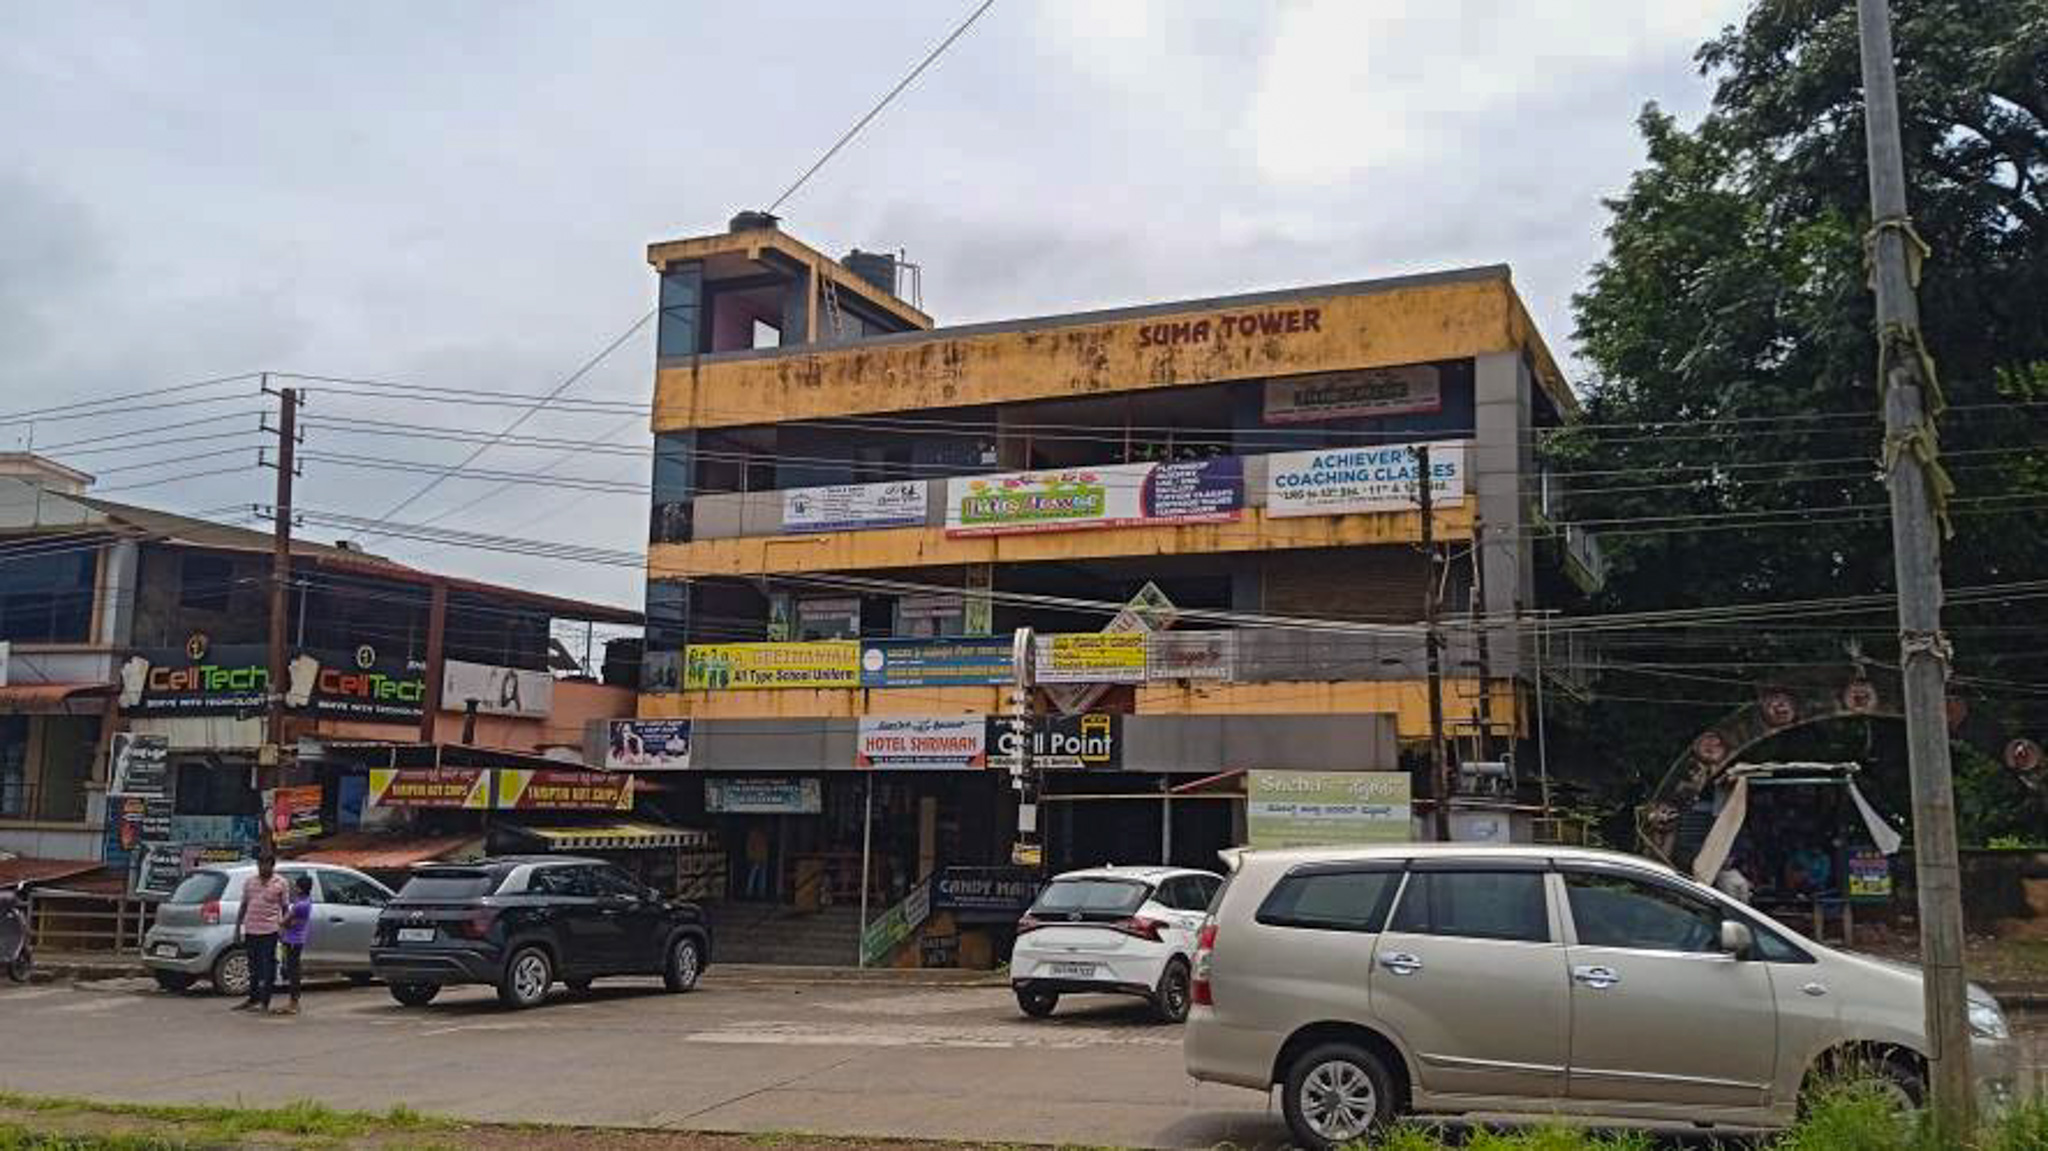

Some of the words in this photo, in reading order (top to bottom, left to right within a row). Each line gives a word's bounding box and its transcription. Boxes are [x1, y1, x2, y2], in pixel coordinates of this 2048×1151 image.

[1139, 320, 1211, 348] SUMA
[1221, 308, 1322, 338] TOWER
[1312, 449, 1418, 469] ACHIEVER'S
[1275, 468, 1368, 488] COACHING
[1375, 463, 1456, 483] CLASES
[150, 665, 269, 690] CellTech
[733, 671, 748, 682] All
[751, 670, 773, 684] Type
[776, 668, 811, 681] School
[813, 667, 855, 680] Uniform
[866, 736, 906, 752] HOTEL
[998, 733, 1043, 755] Cll
[1050, 731, 1113, 755] Point
[940, 879, 992, 896] CANDY
